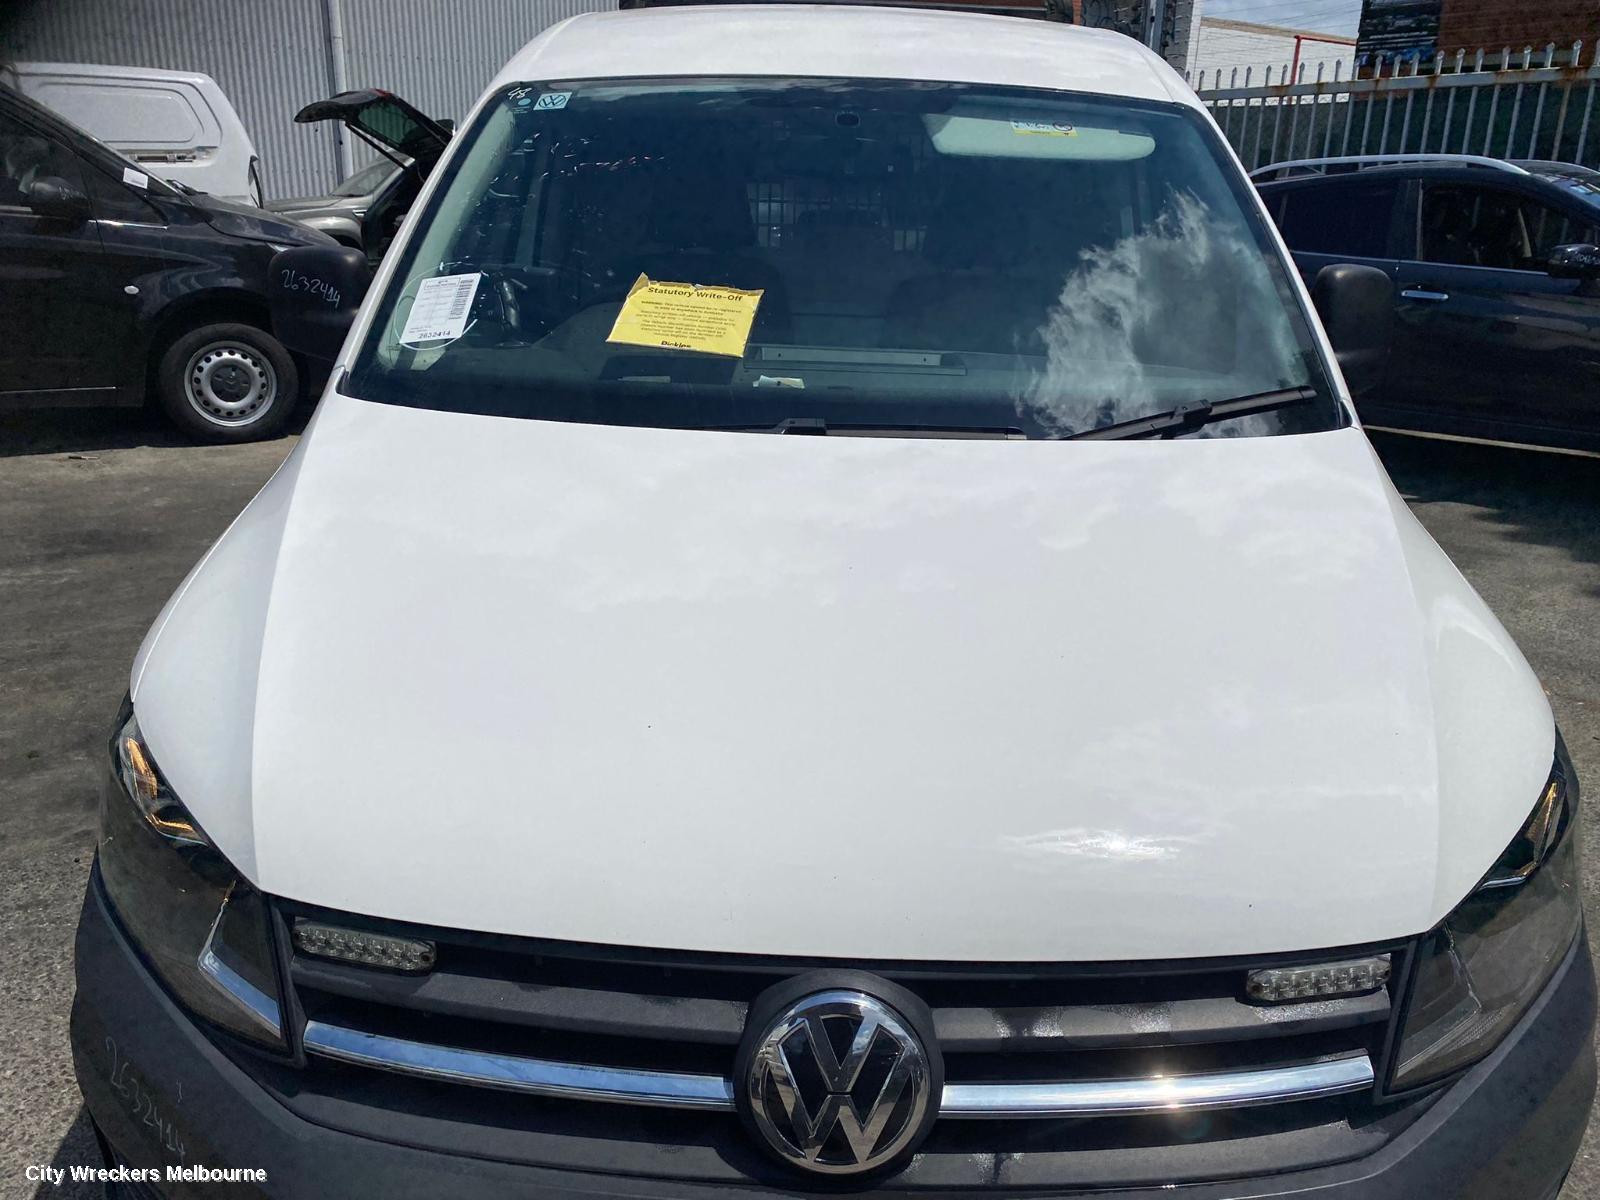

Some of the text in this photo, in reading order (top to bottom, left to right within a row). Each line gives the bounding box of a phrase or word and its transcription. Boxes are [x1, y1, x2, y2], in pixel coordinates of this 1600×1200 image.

[281, 269, 341, 309] 2632414
[647, 287, 744, 302] Statutory Write-Off
[417, 330, 451, 339] 2632414
[105, 1036, 186, 1167] 2632414
